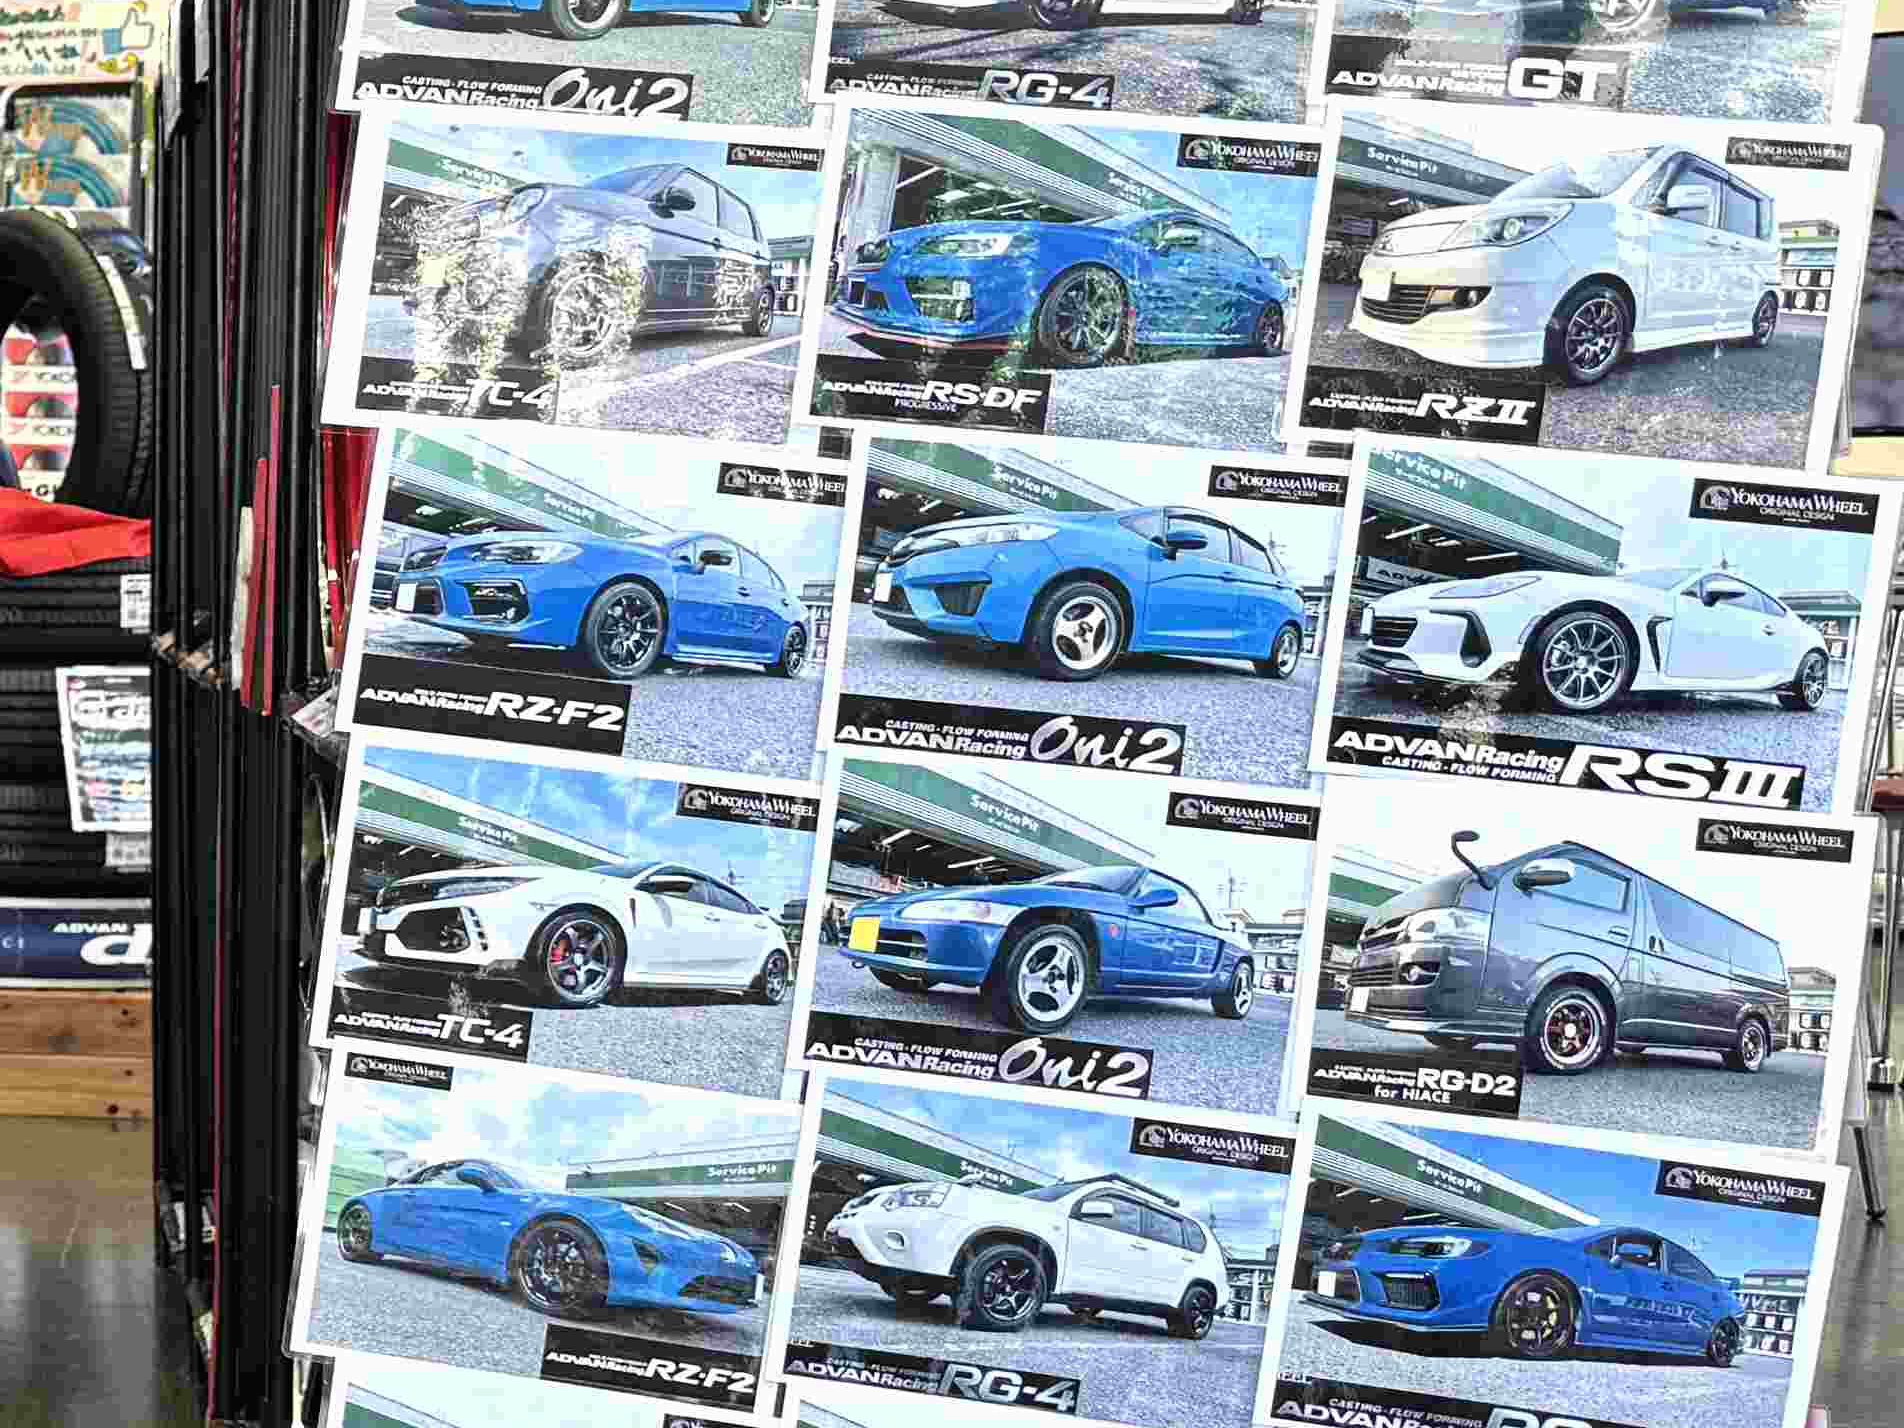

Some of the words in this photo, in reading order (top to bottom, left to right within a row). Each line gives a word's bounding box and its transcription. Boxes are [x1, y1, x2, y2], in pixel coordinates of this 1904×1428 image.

[977, 69, 1114, 109] RG-4
[1505, 57, 1607, 100] GT
[1380, 754, 1441, 773] CASTING
[1450, 759, 1489, 777] FLOW
[435, 1012, 525, 1049] TC-4
[1374, 1083, 1397, 1103] for
[1400, 1086, 1451, 1105] HIACE
[1415, 1067, 1517, 1097] RG-D2
[936, 1363, 1080, 1412] RG-4
